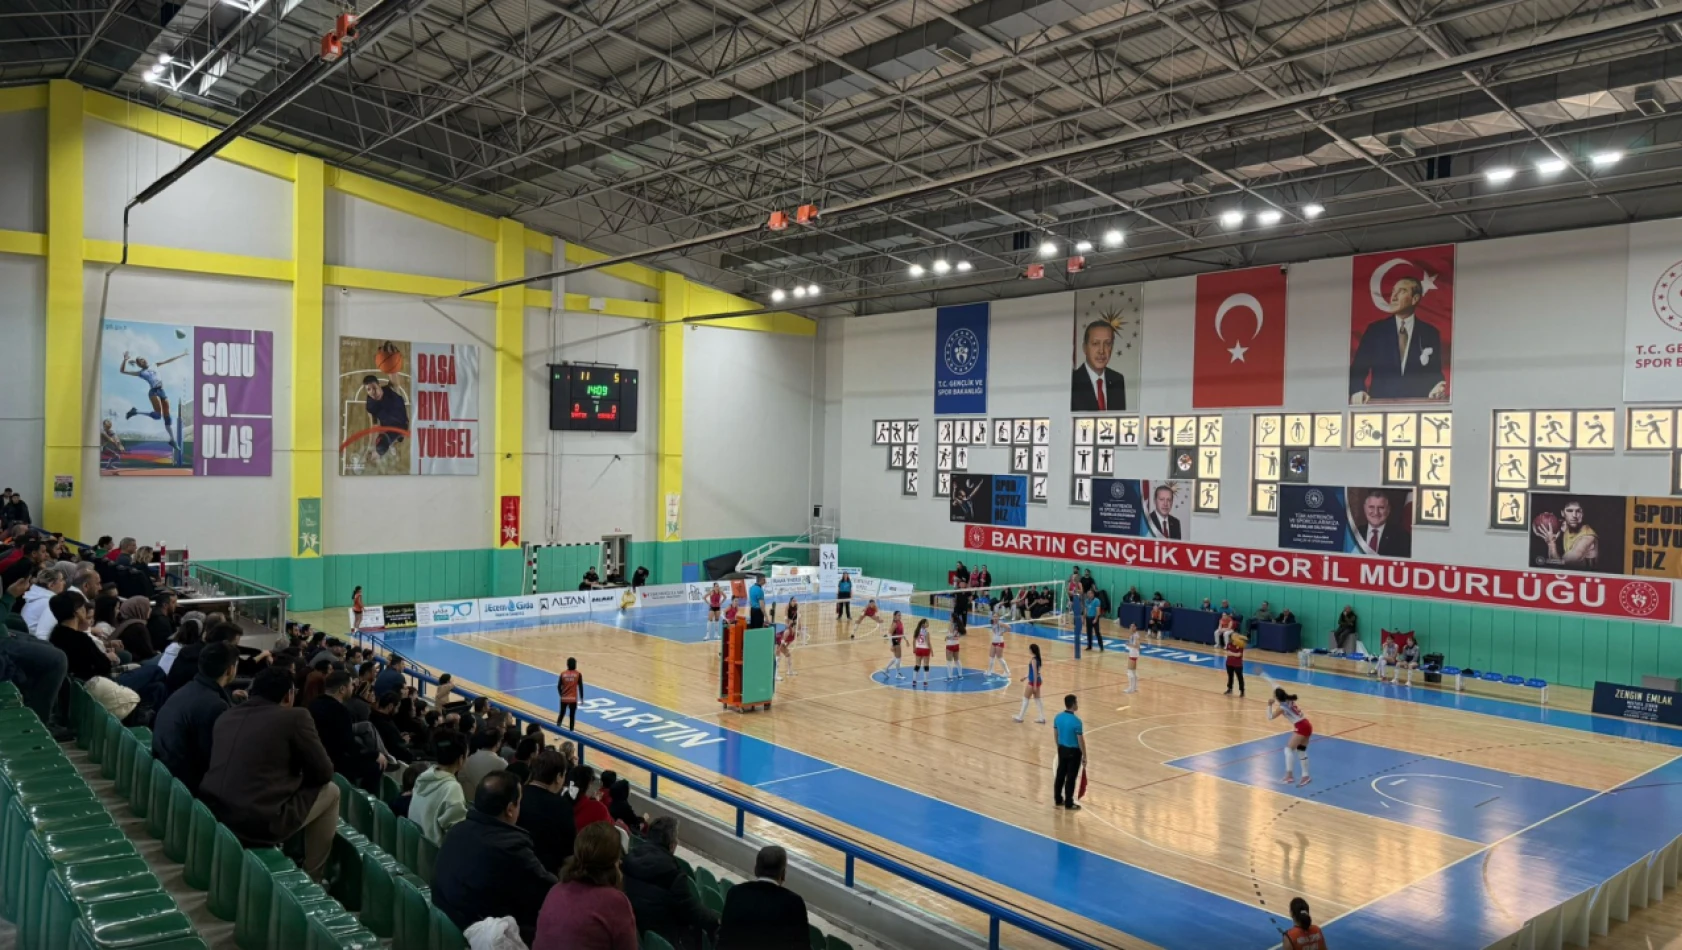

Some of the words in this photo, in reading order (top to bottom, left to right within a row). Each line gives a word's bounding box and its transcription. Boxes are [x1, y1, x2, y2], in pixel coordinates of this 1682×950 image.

[202, 341, 255, 377] SONU
[1636, 344, 1661, 355] T.C.
[580, 371, 591, 381] 11
[1636, 358, 1672, 369] SPOR
[202, 383, 228, 418] CA
[202, 424, 253, 463] ULAŞ
[417, 425, 475, 459] YÜKSEL
[1634, 504, 1682, 525] SPOR
[991, 531, 1066, 554] BARTIN
[1073, 538, 1179, 566] GENÇLİK
[1186, 548, 1221, 570] VE
[1230, 552, 1312, 579] SPOR
[1321, 555, 1349, 583] İL
[1359, 561, 1606, 608] MÜDÜRLÜĞÜ
[552, 595, 586, 606] ALTAN
[1646, 693, 1673, 706] EMLAK
[577, 697, 727, 748] BARTIN
